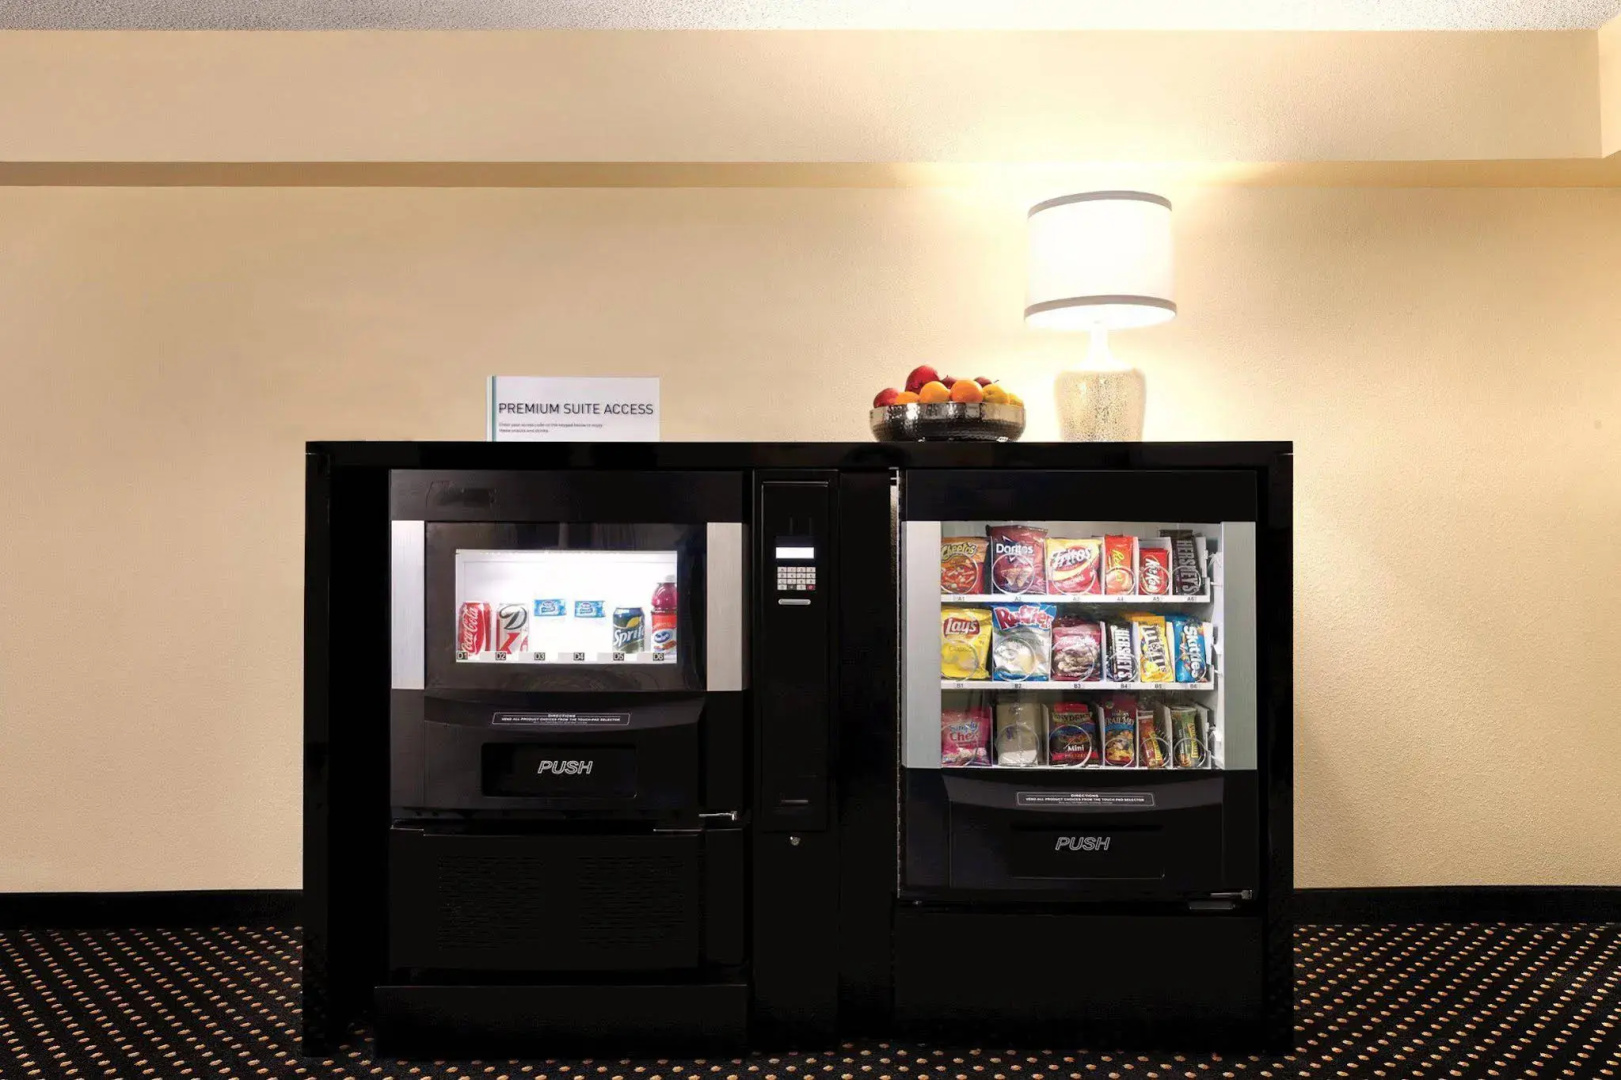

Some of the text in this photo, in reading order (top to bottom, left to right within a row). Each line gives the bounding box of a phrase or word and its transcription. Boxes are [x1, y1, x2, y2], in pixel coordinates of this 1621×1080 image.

[499, 403, 654, 415] PREMIUM SUITE ACCESS
[941, 542, 977, 561] Cheetos
[995, 543, 1034, 555] Doritos
[1050, 547, 1092, 570] Fritos
[1183, 625, 1201, 678] Skittles
[537, 760, 594, 774] PUSH
[1055, 836, 1111, 851] PUSH
